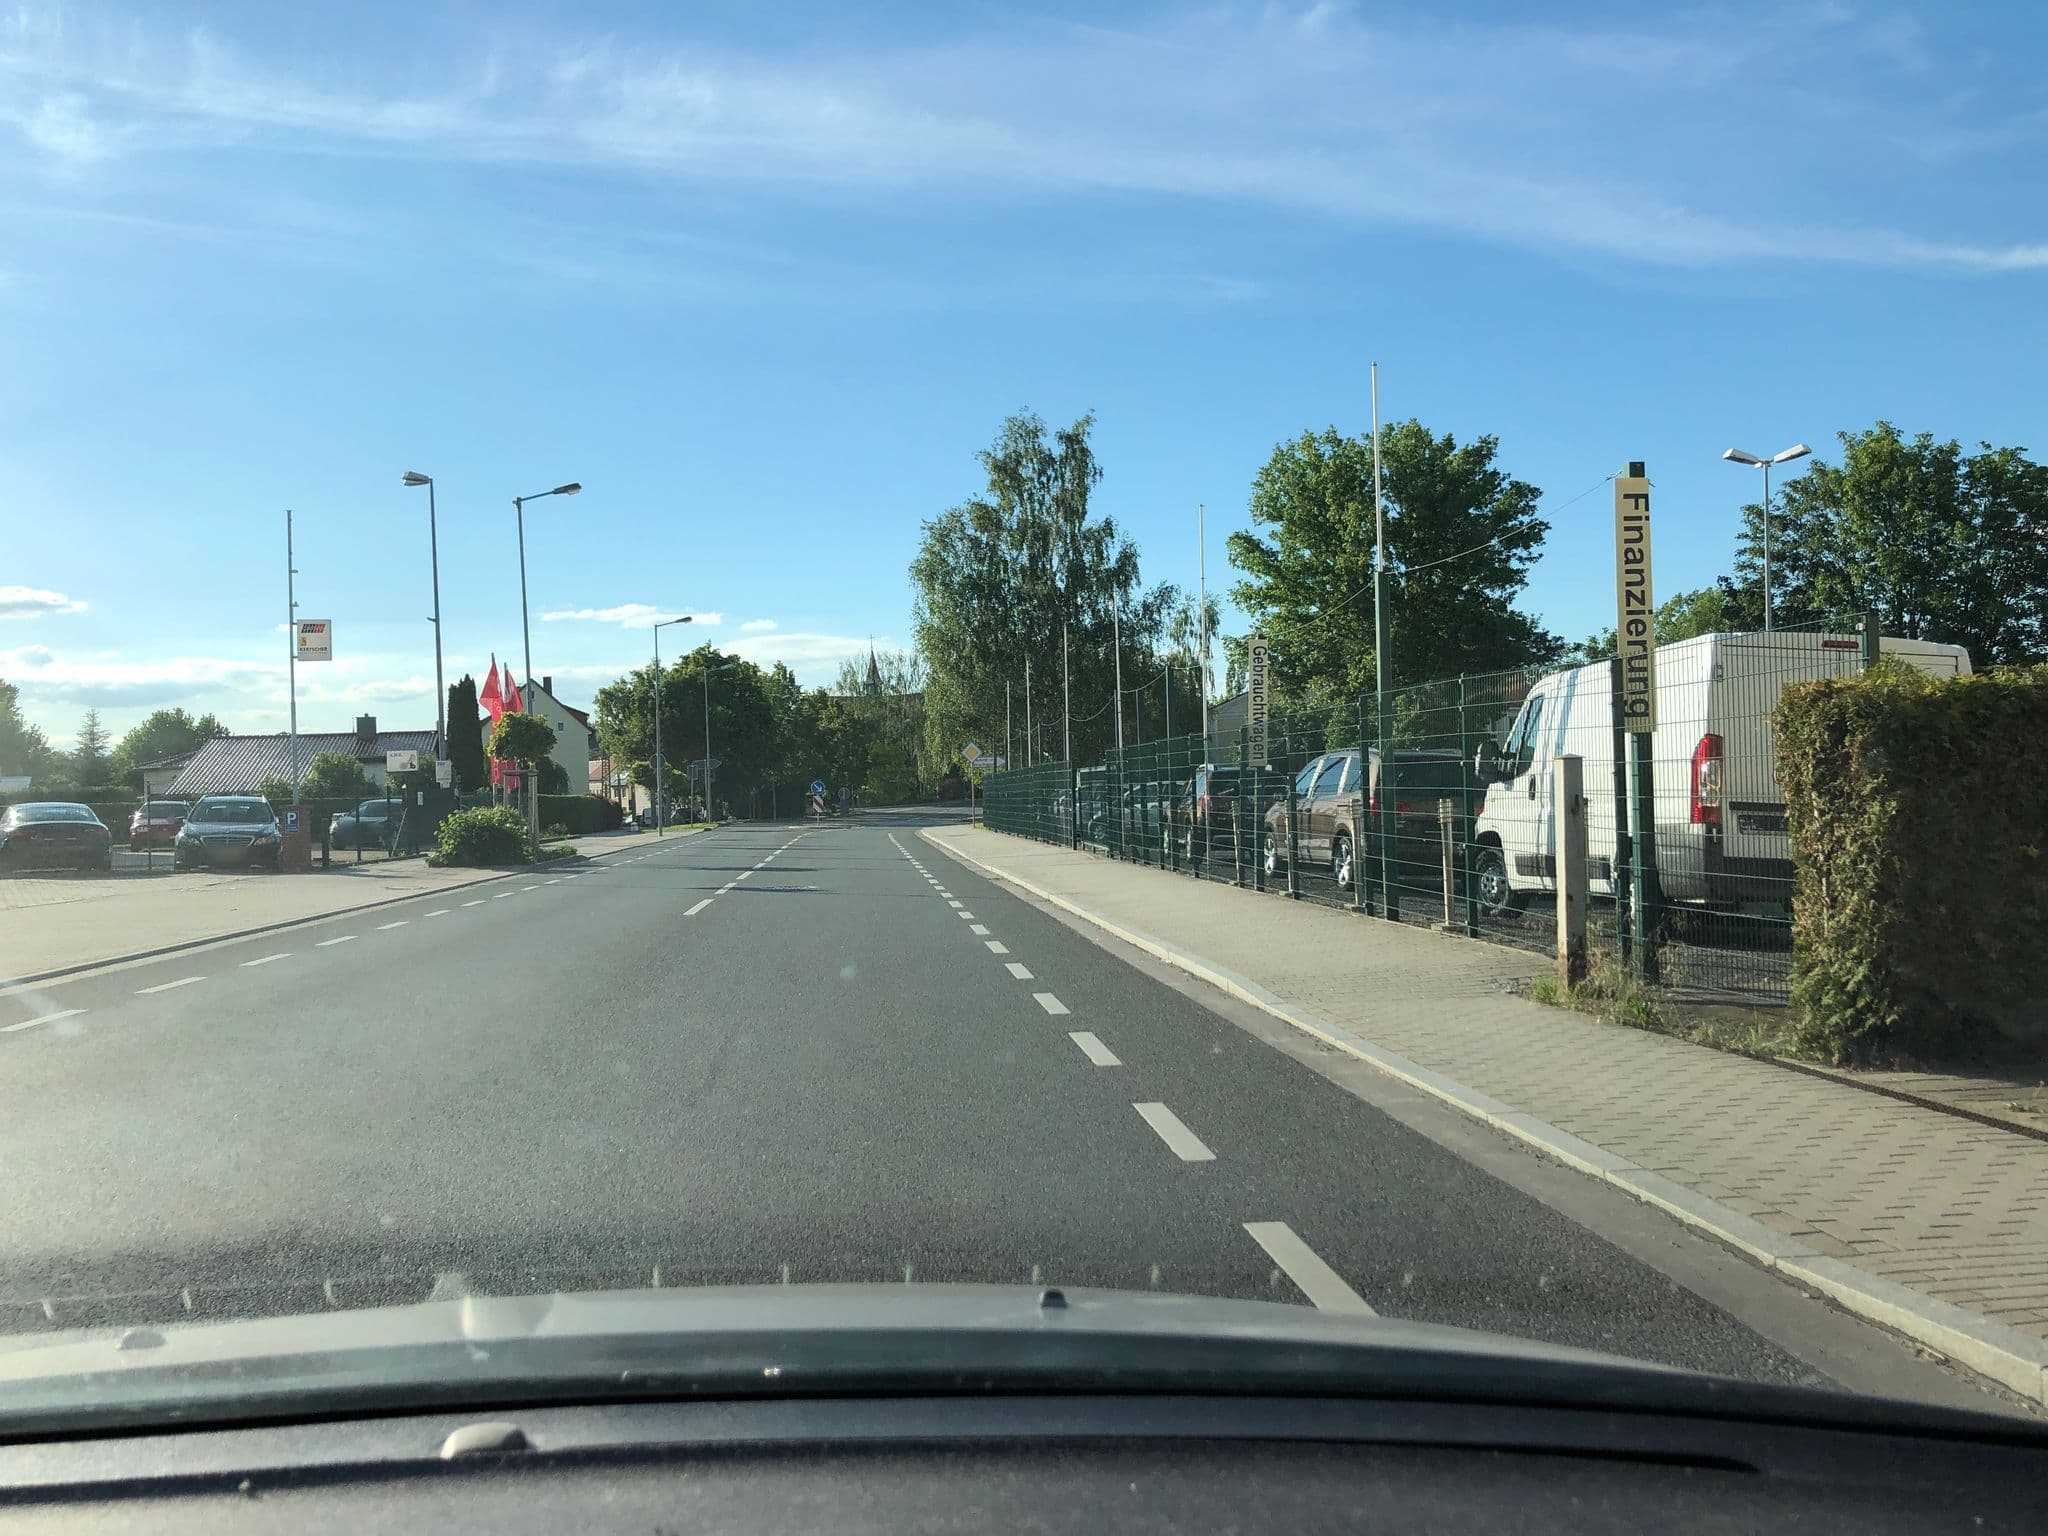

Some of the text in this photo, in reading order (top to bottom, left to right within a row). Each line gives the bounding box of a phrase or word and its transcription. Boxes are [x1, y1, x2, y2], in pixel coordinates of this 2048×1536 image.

[1623, 492, 1653, 719] Finanzierung
[1249, 645, 1268, 760] Gebrauchtwagen
[287, 812, 297, 825] P
